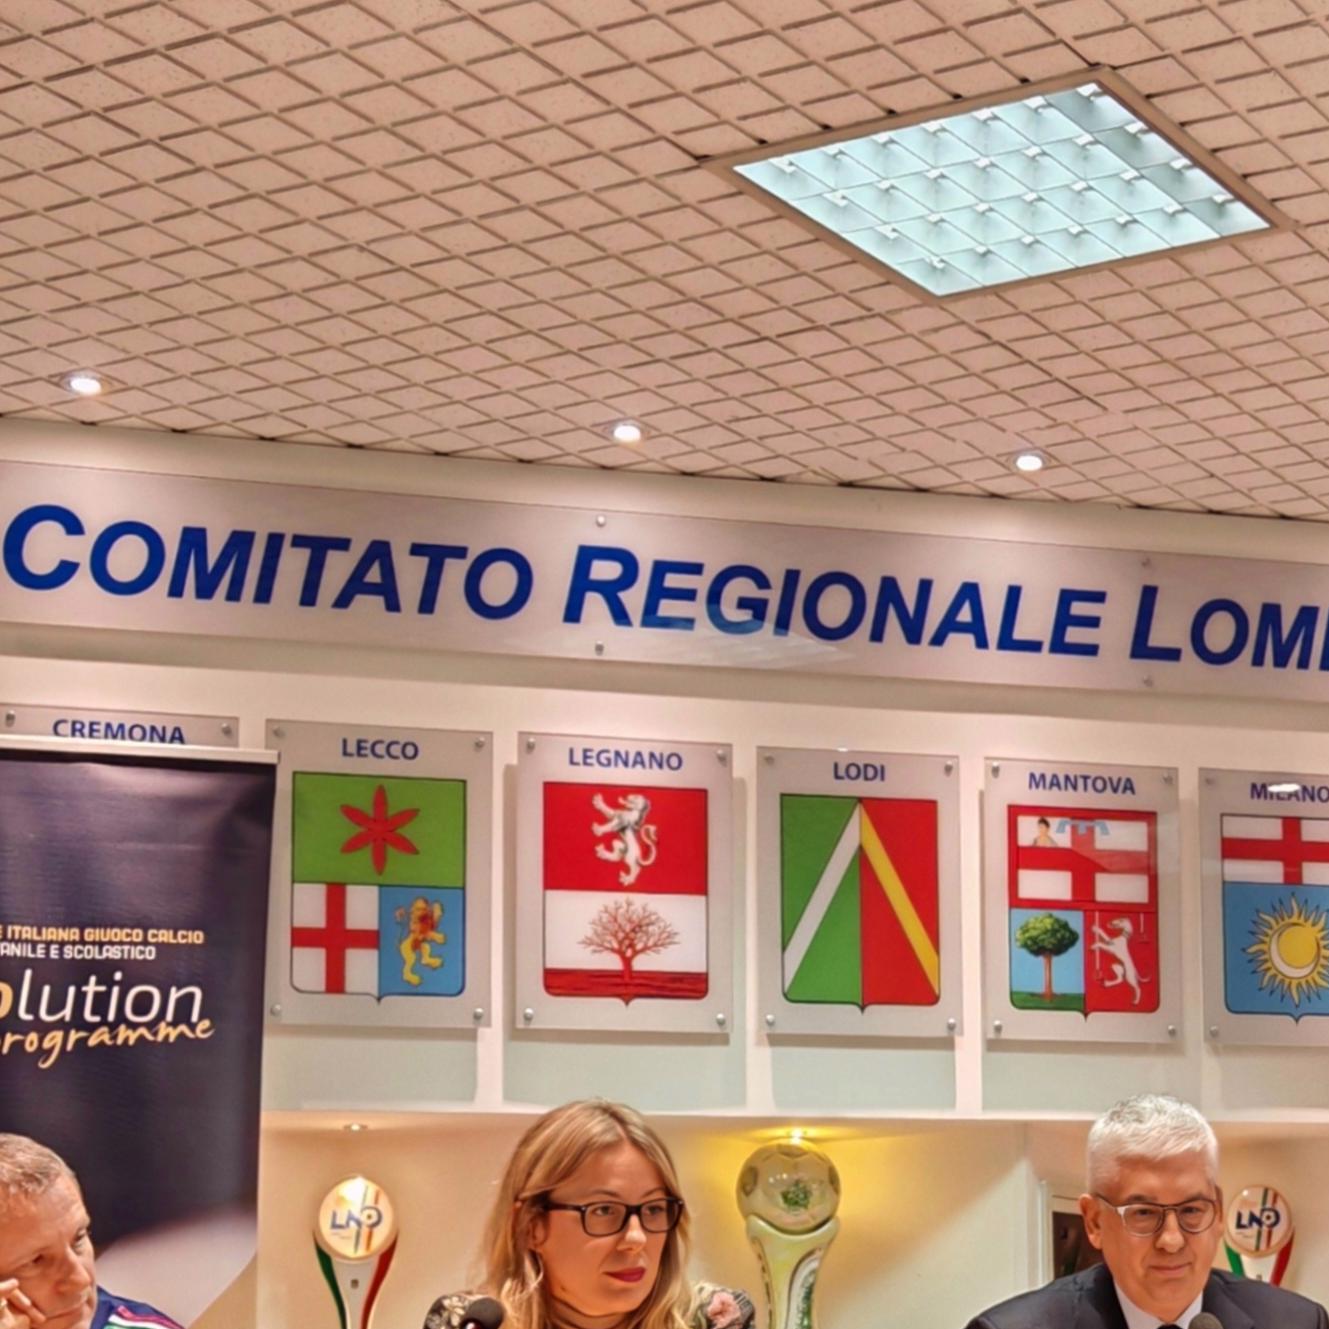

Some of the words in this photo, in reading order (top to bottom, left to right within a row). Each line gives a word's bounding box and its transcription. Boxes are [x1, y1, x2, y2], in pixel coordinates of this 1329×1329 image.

[2, 503, 534, 621] COMITATO
[562, 544, 1108, 658] REGIONALE
[53, 718, 186, 745] CREMONA
[341, 737, 420, 761] LECCO
[568, 746, 684, 771] LEGNANO
[832, 761, 886, 782] LODI
[1028, 771, 1137, 796] MANTOVA
[7, 924, 80, 942] ITALIANA
[83, 927, 144, 943] GIUOCO
[147, 929, 205, 944] CALCIO
[0, 941, 46, 959] ANILE
[49, 943, 60, 959] E
[63, 944, 157, 961] SCOLASTICO
[0, 968, 203, 1023] lution
[2, 1018, 216, 1069] rogramme
